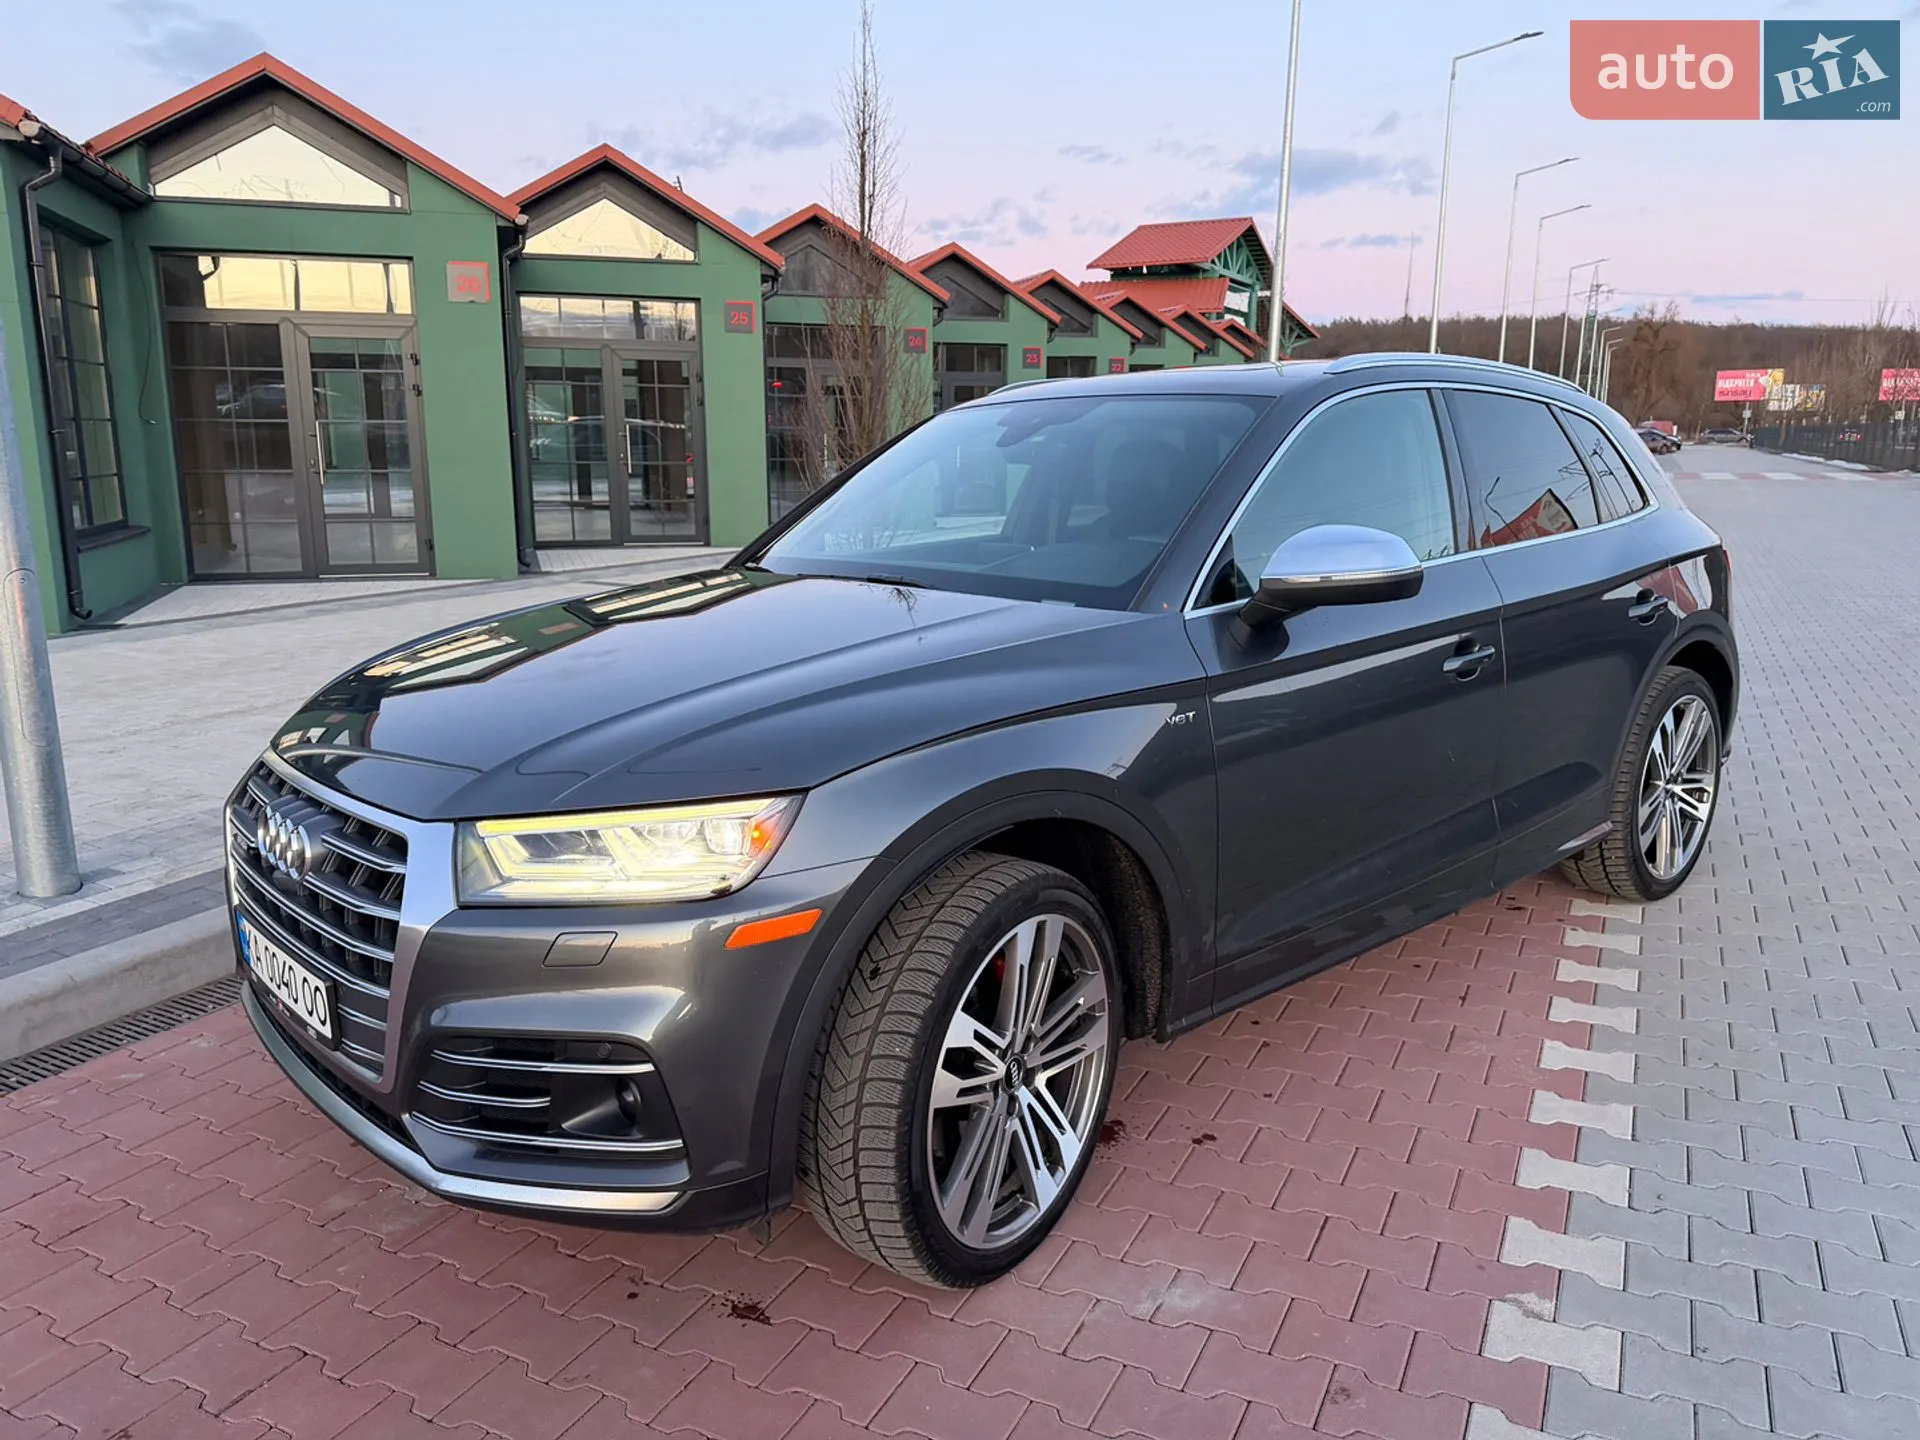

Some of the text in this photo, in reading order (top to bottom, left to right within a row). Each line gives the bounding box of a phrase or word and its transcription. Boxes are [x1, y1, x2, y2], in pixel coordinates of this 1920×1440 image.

[455, 274, 481, 293] 26
[730, 311, 749, 325] 25
[1026, 353, 1039, 364] 23
[1111, 363, 1121, 372] 22
[264, 945, 299, 1005] 0040
